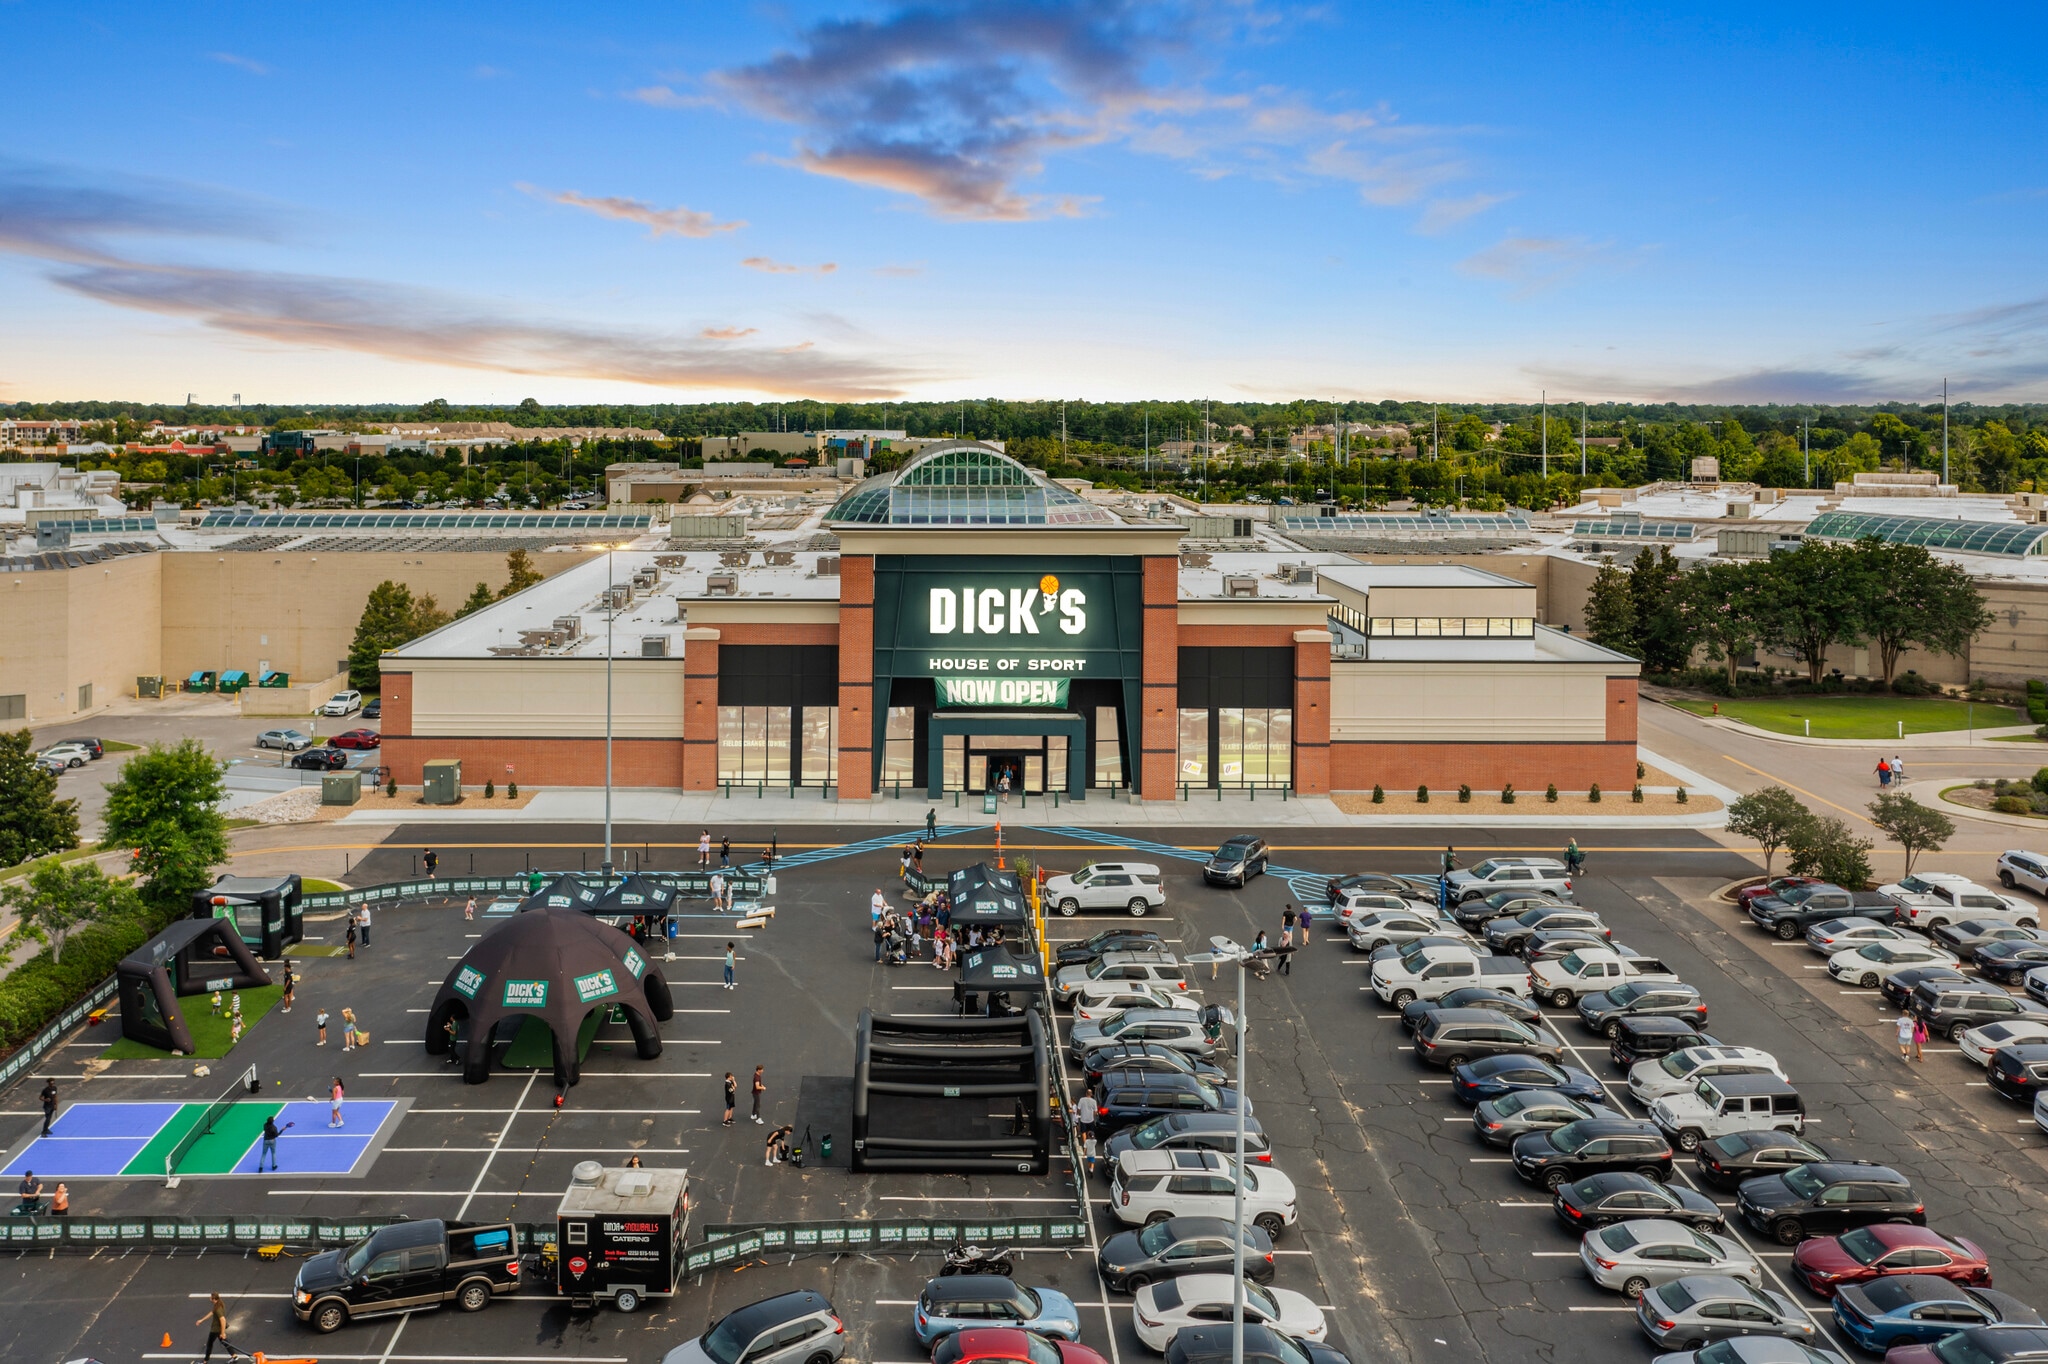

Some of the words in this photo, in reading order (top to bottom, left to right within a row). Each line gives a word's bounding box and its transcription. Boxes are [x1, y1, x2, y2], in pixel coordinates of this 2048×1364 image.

[930, 574, 1086, 634] DICK'S
[929, 658, 990, 670] HOUSE
[996, 659, 1020, 671] OF
[1028, 660, 1087, 671] SPORT
[946, 680, 996, 703] NOW
[1000, 680, 1058, 704] OPEN
[459, 968, 482, 989] DICK'S
[578, 972, 612, 992] DICK'S
[207, 978, 232, 990] DICK'S
[507, 982, 544, 997] DICK'S
[12, 1226, 33, 1236] DICK'S
[38, 1224, 61, 1235] DICK'S
[70, 1225, 91, 1235] DICK'S
[95, 1225, 117, 1235] DICK'S
[121, 1224, 144, 1234] DICK'S
[153, 1225, 175, 1235] DICK'S
[179, 1225, 200, 1235] DICK'S
[205, 1225, 228, 1234] DICK'S
[235, 1225, 256, 1235] DICK'S
[260, 1225, 282, 1235] DICK'S
[286, 1225, 309, 1234] DICK'S
[318, 1226, 340, 1236] DICK'S
[344, 1226, 367, 1236] DICK'S
[624, 1223, 658, 1232] SNOWBALLS
[880, 1228, 902, 1237] DICK'S
[906, 1227, 929, 1236] DICK'S
[966, 1227, 988, 1236] DICK'S
[992, 1226, 1015, 1235] DICK'S
[1019, 1225, 1042, 1234] DICK'S
[1051, 1225, 1074, 1234] DICK'S
[794, 1231, 818, 1240] DICK'S
[822, 1229, 844, 1239] DICK'S
[849, 1229, 872, 1238] DICK'S
[739, 1238, 761, 1251] DICK'S
[713, 1245, 736, 1258] DICK'S
[688, 1252, 711, 1265] DICK'S
